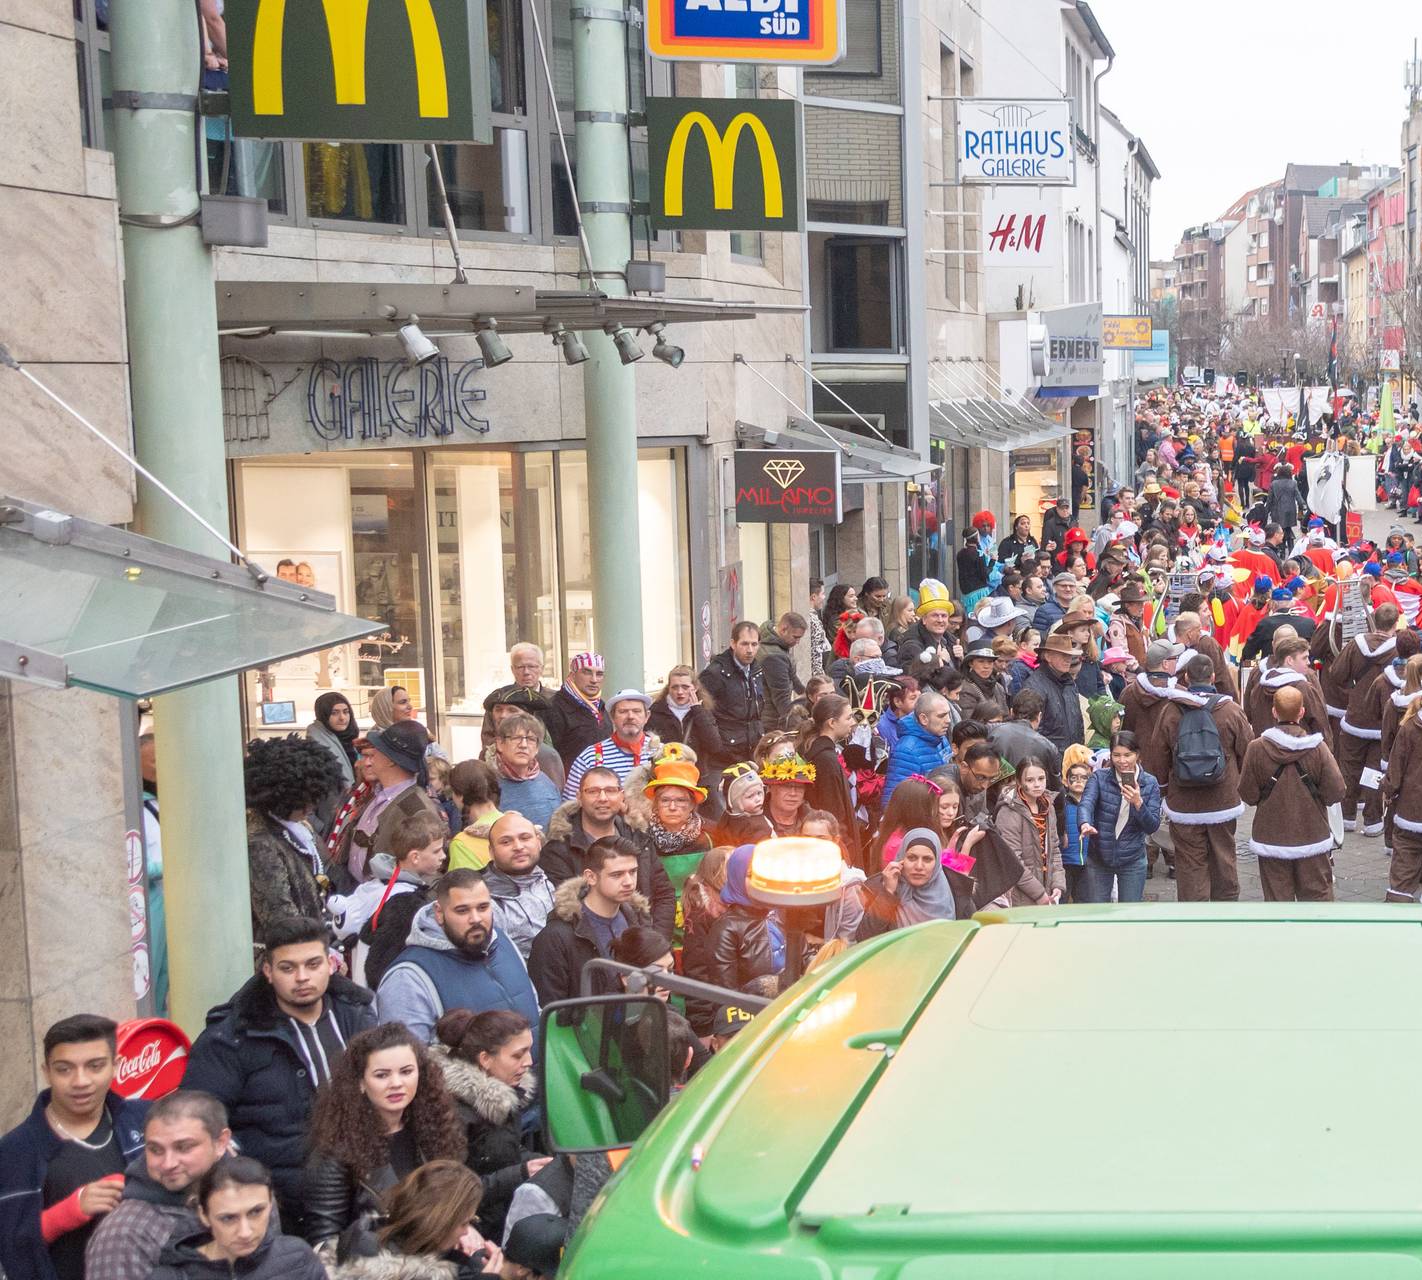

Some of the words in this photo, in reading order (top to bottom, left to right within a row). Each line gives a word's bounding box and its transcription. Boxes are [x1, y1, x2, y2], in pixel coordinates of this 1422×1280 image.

[760, 12, 800, 35] SÜD
[965, 130, 1064, 159] RATHAUS
[982, 158, 1046, 176] GALERIE
[989, 213, 1046, 253] H&M
[308, 357, 490, 441] GALERIE
[735, 486, 834, 513] MILANO
